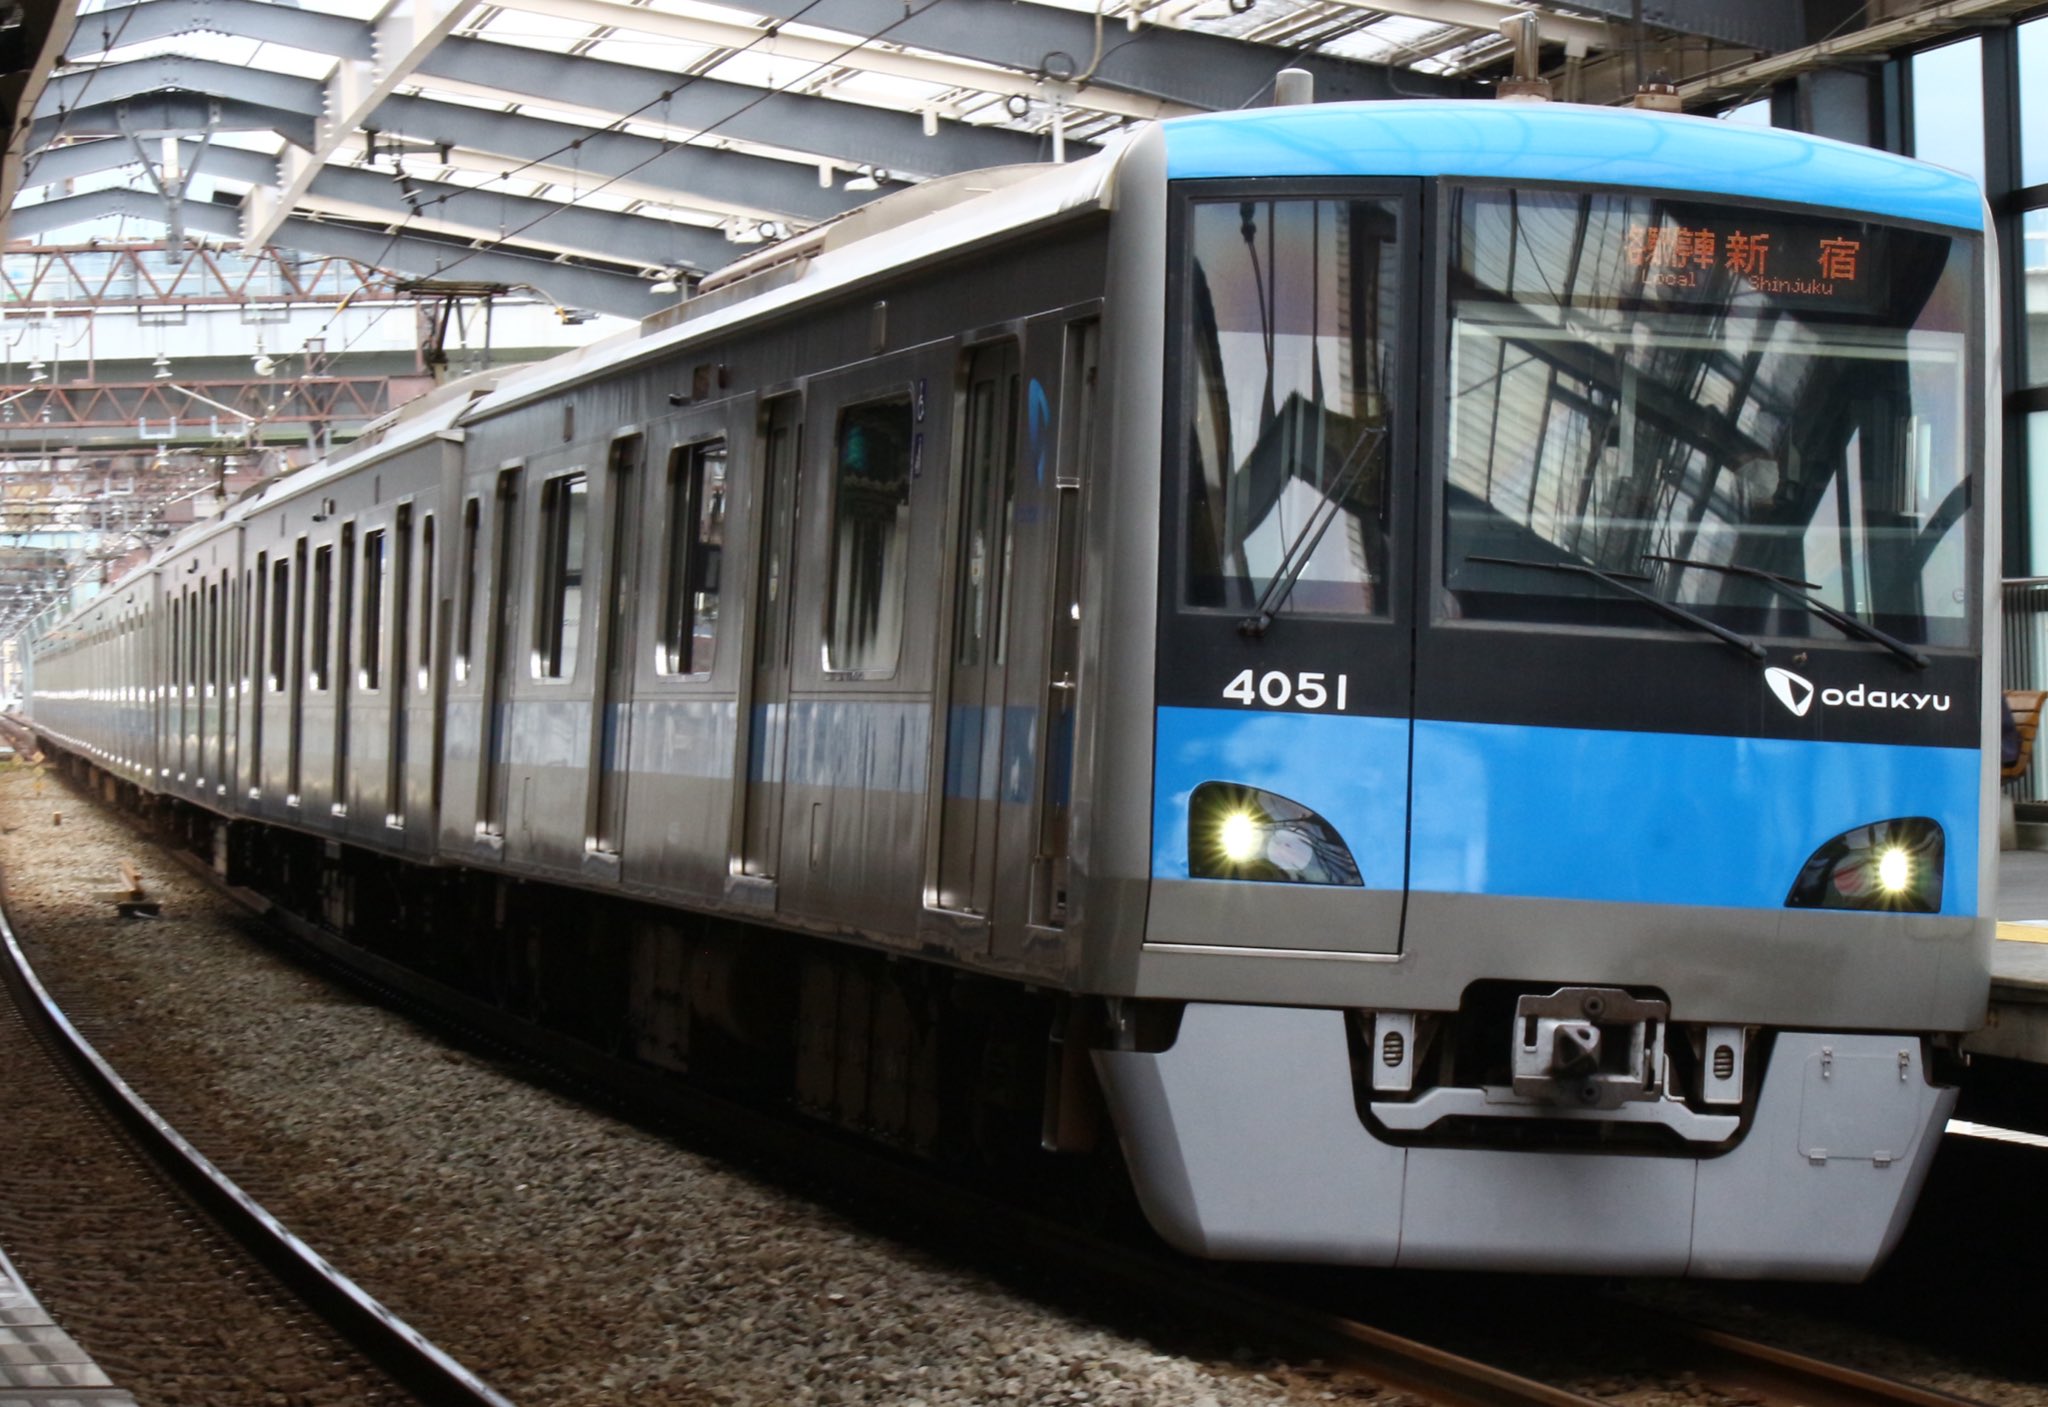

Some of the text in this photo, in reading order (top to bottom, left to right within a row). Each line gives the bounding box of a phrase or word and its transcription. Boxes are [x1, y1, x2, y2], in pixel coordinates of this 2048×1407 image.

[1642, 269, 1833, 295] Local Shinjuku
[1223, 669, 1347, 710] 4051
